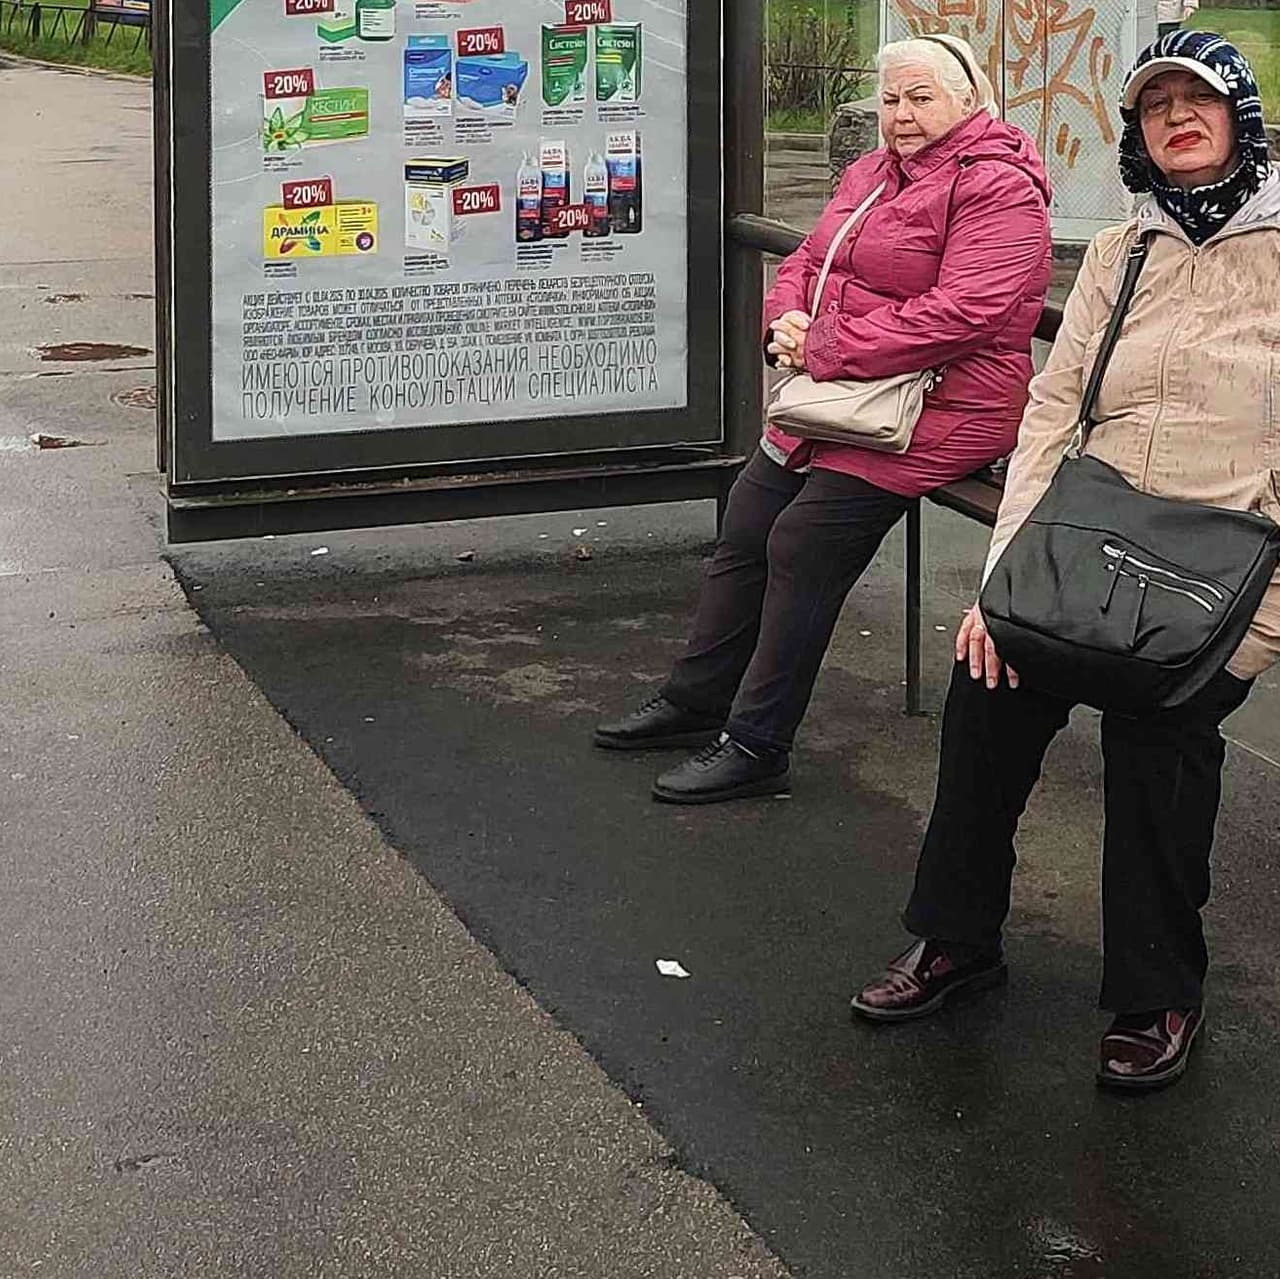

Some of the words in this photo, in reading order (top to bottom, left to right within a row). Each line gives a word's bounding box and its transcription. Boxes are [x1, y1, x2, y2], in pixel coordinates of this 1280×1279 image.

[568, 2, 606, 22] -20%
[461, 32, 499, 52] -20%
[268, 74, 308, 94] -20%
[311, 97, 357, 113] КЕСТИН
[285, 184, 326, 205] -20%
[456, 189, 495, 211] -20%
[552, 208, 589, 228] -20%
[271, 225, 330, 239] ДРАМИНА
[242, 360, 334, 390] ИМЕЮТСЯ
[538, 338, 657, 370] НЕОБХОДИМО
[241, 387, 357, 419] ПОЛУЧЕНИЕ
[369, 376, 516, 411] КОНСУЛЬТАЦИИ
[528, 366, 658, 400] СПЕЦИАЛИСТА
